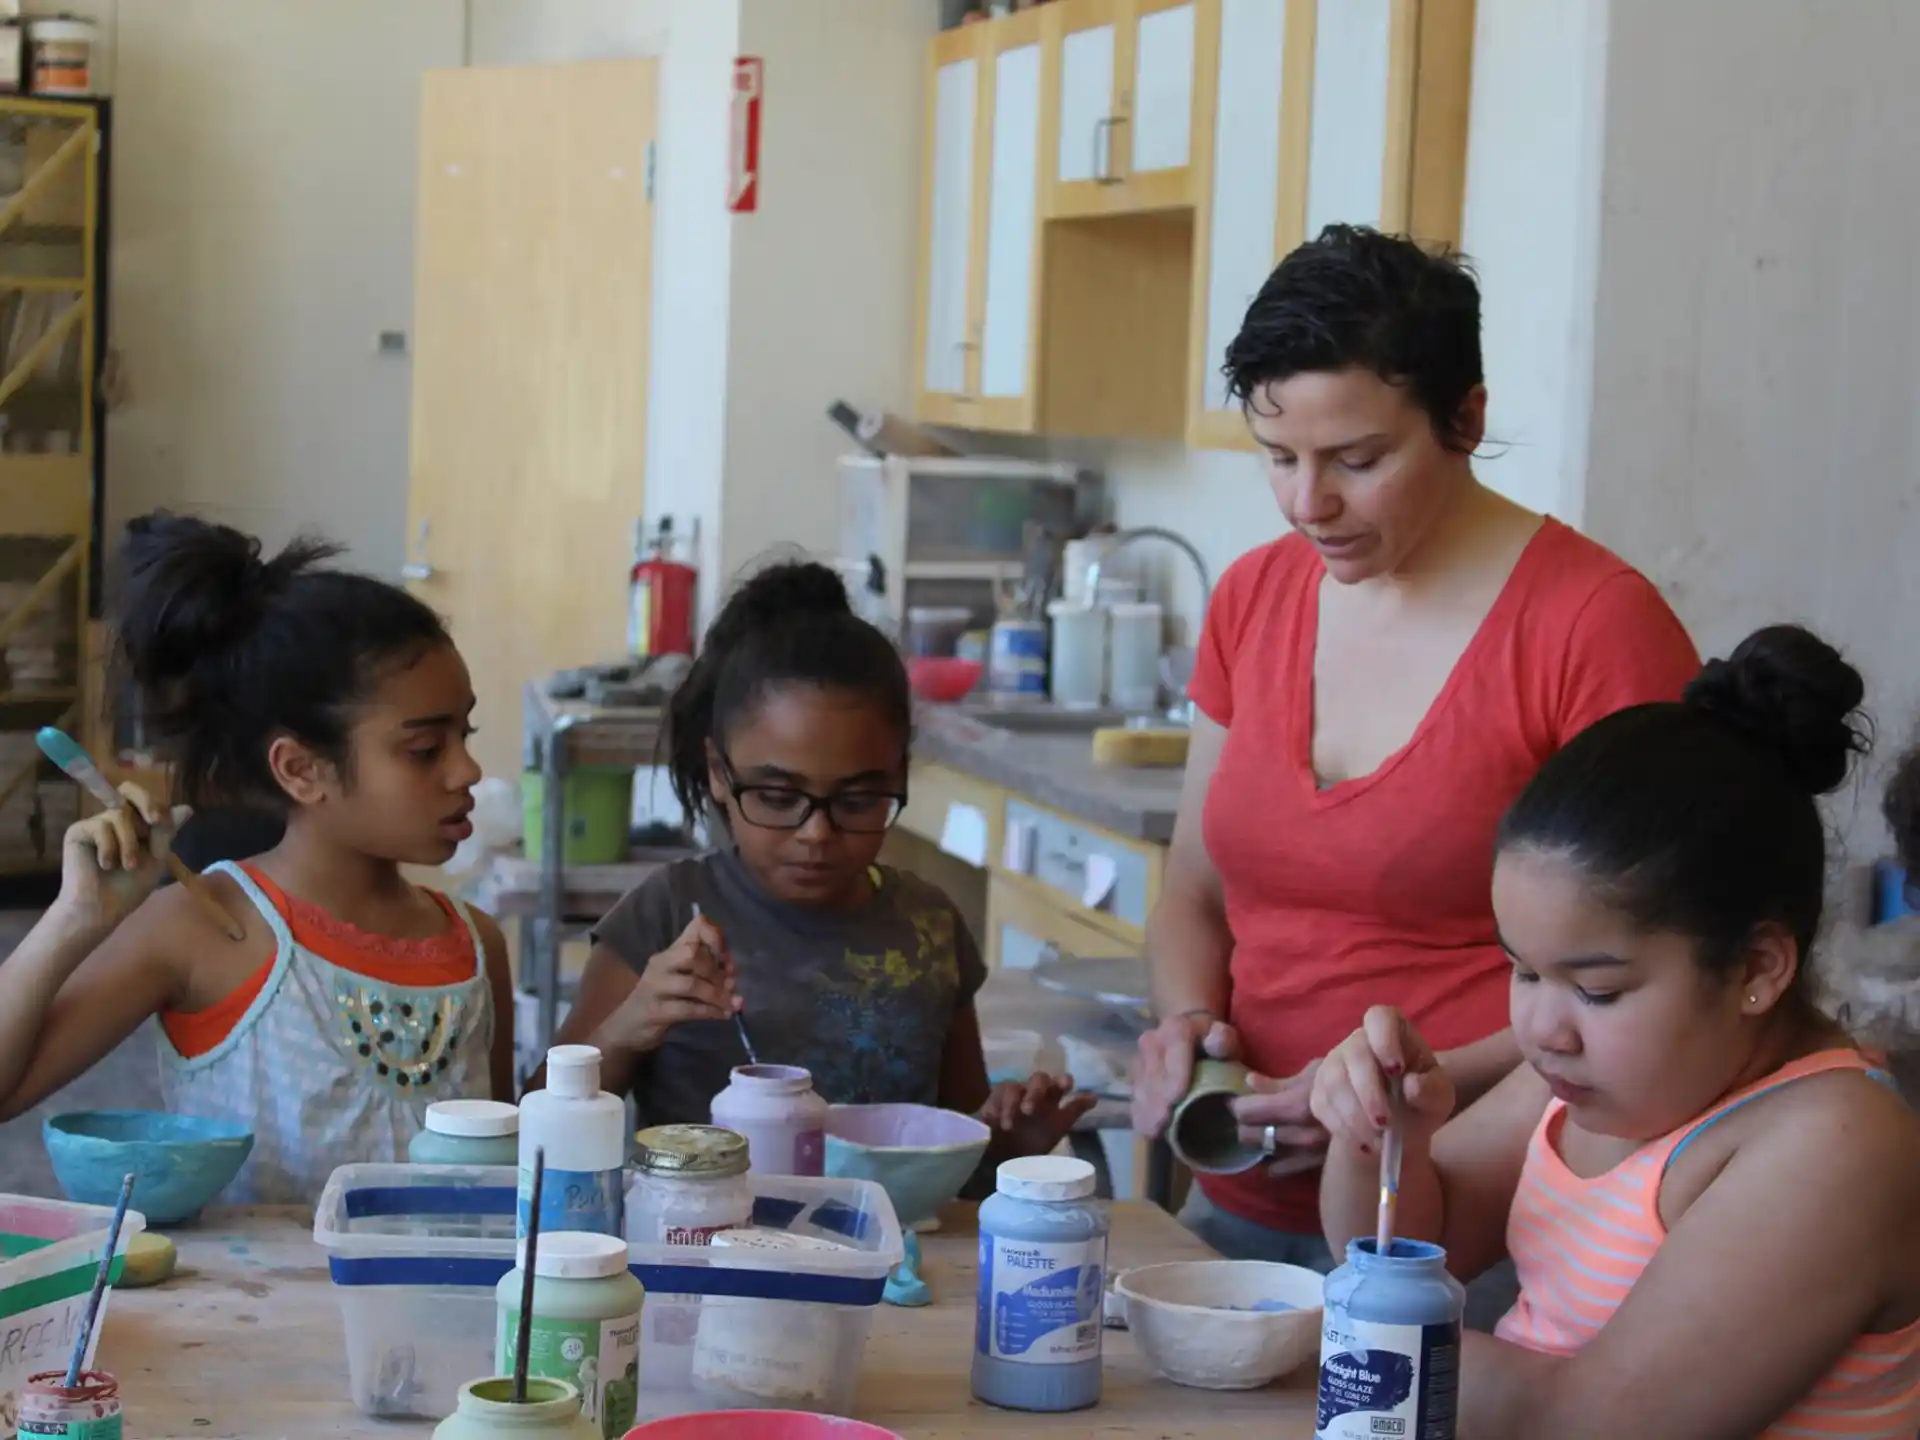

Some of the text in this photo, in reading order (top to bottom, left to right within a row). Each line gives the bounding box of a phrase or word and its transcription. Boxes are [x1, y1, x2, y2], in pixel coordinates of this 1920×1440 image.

[1007, 1255, 1056, 1270] PALETTE
[0, 1306, 79, 1372] REEN
[1326, 1359, 1381, 1384] Midnight Blue
[1328, 1375, 1374, 1395] GLOSS GLAZE
